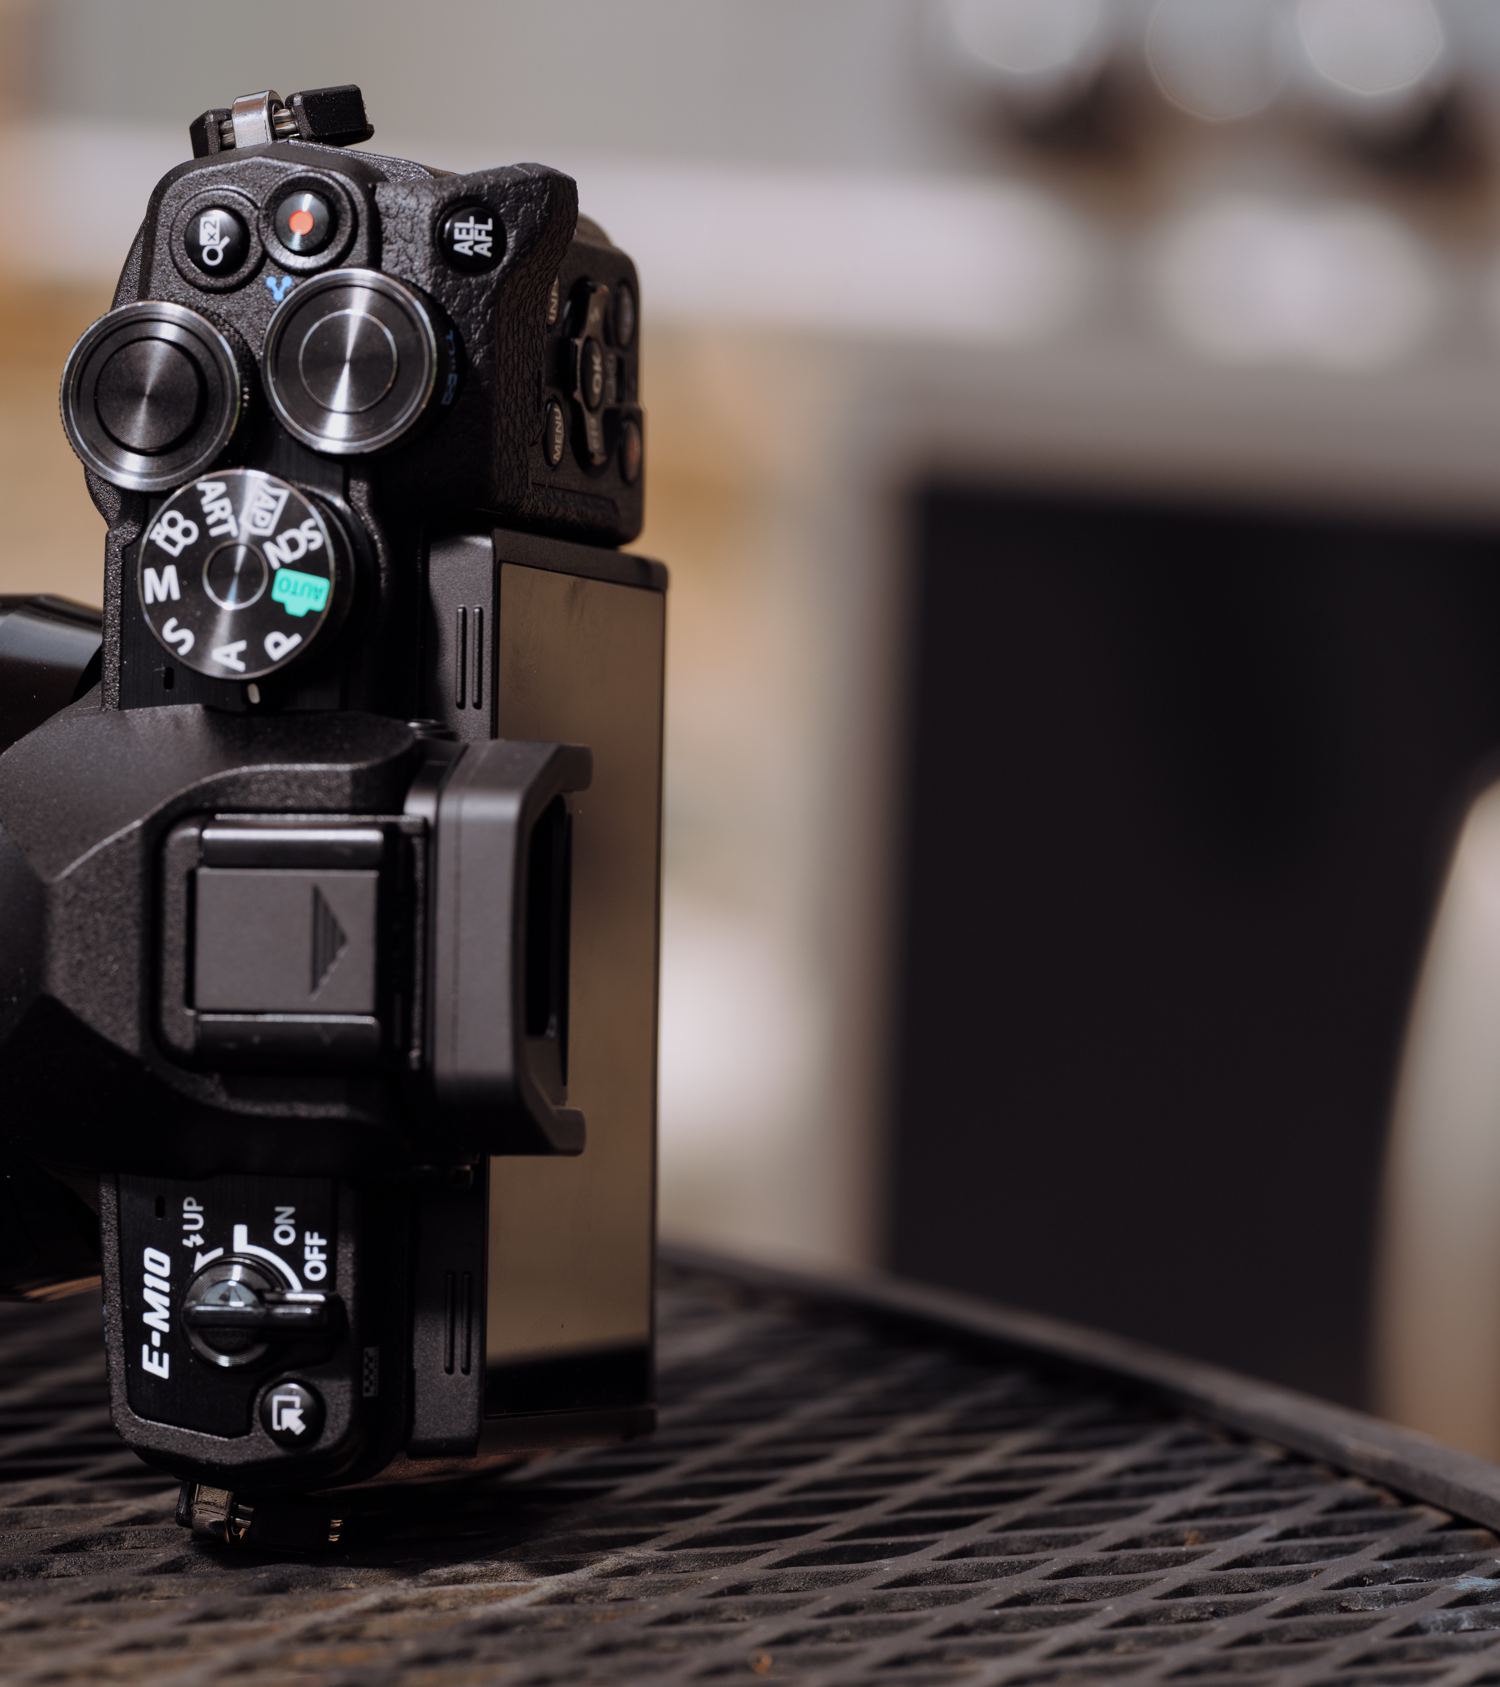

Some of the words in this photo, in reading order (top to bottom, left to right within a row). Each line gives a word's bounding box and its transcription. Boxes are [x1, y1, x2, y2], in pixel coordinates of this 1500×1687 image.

[453, 215, 475, 256] AEL
[473, 217, 494, 258] AFL
[548, 276, 559, 321] INF
[592, 353, 603, 395] OK
[552, 407, 564, 461] MENU
[196, 481, 239, 538] ART
[262, 518, 325, 570] SCN
[143, 564, 182, 605] M
[278, 576, 325, 601] AUTO
[162, 616, 196, 657] S
[210, 639, 248, 673] A
[263, 630, 303, 662] P
[182, 1196, 204, 1230] UP
[273, 1206, 296, 1246] ON
[303, 1231, 328, 1282] OFF
[142, 1247, 171, 1380] E-M10
